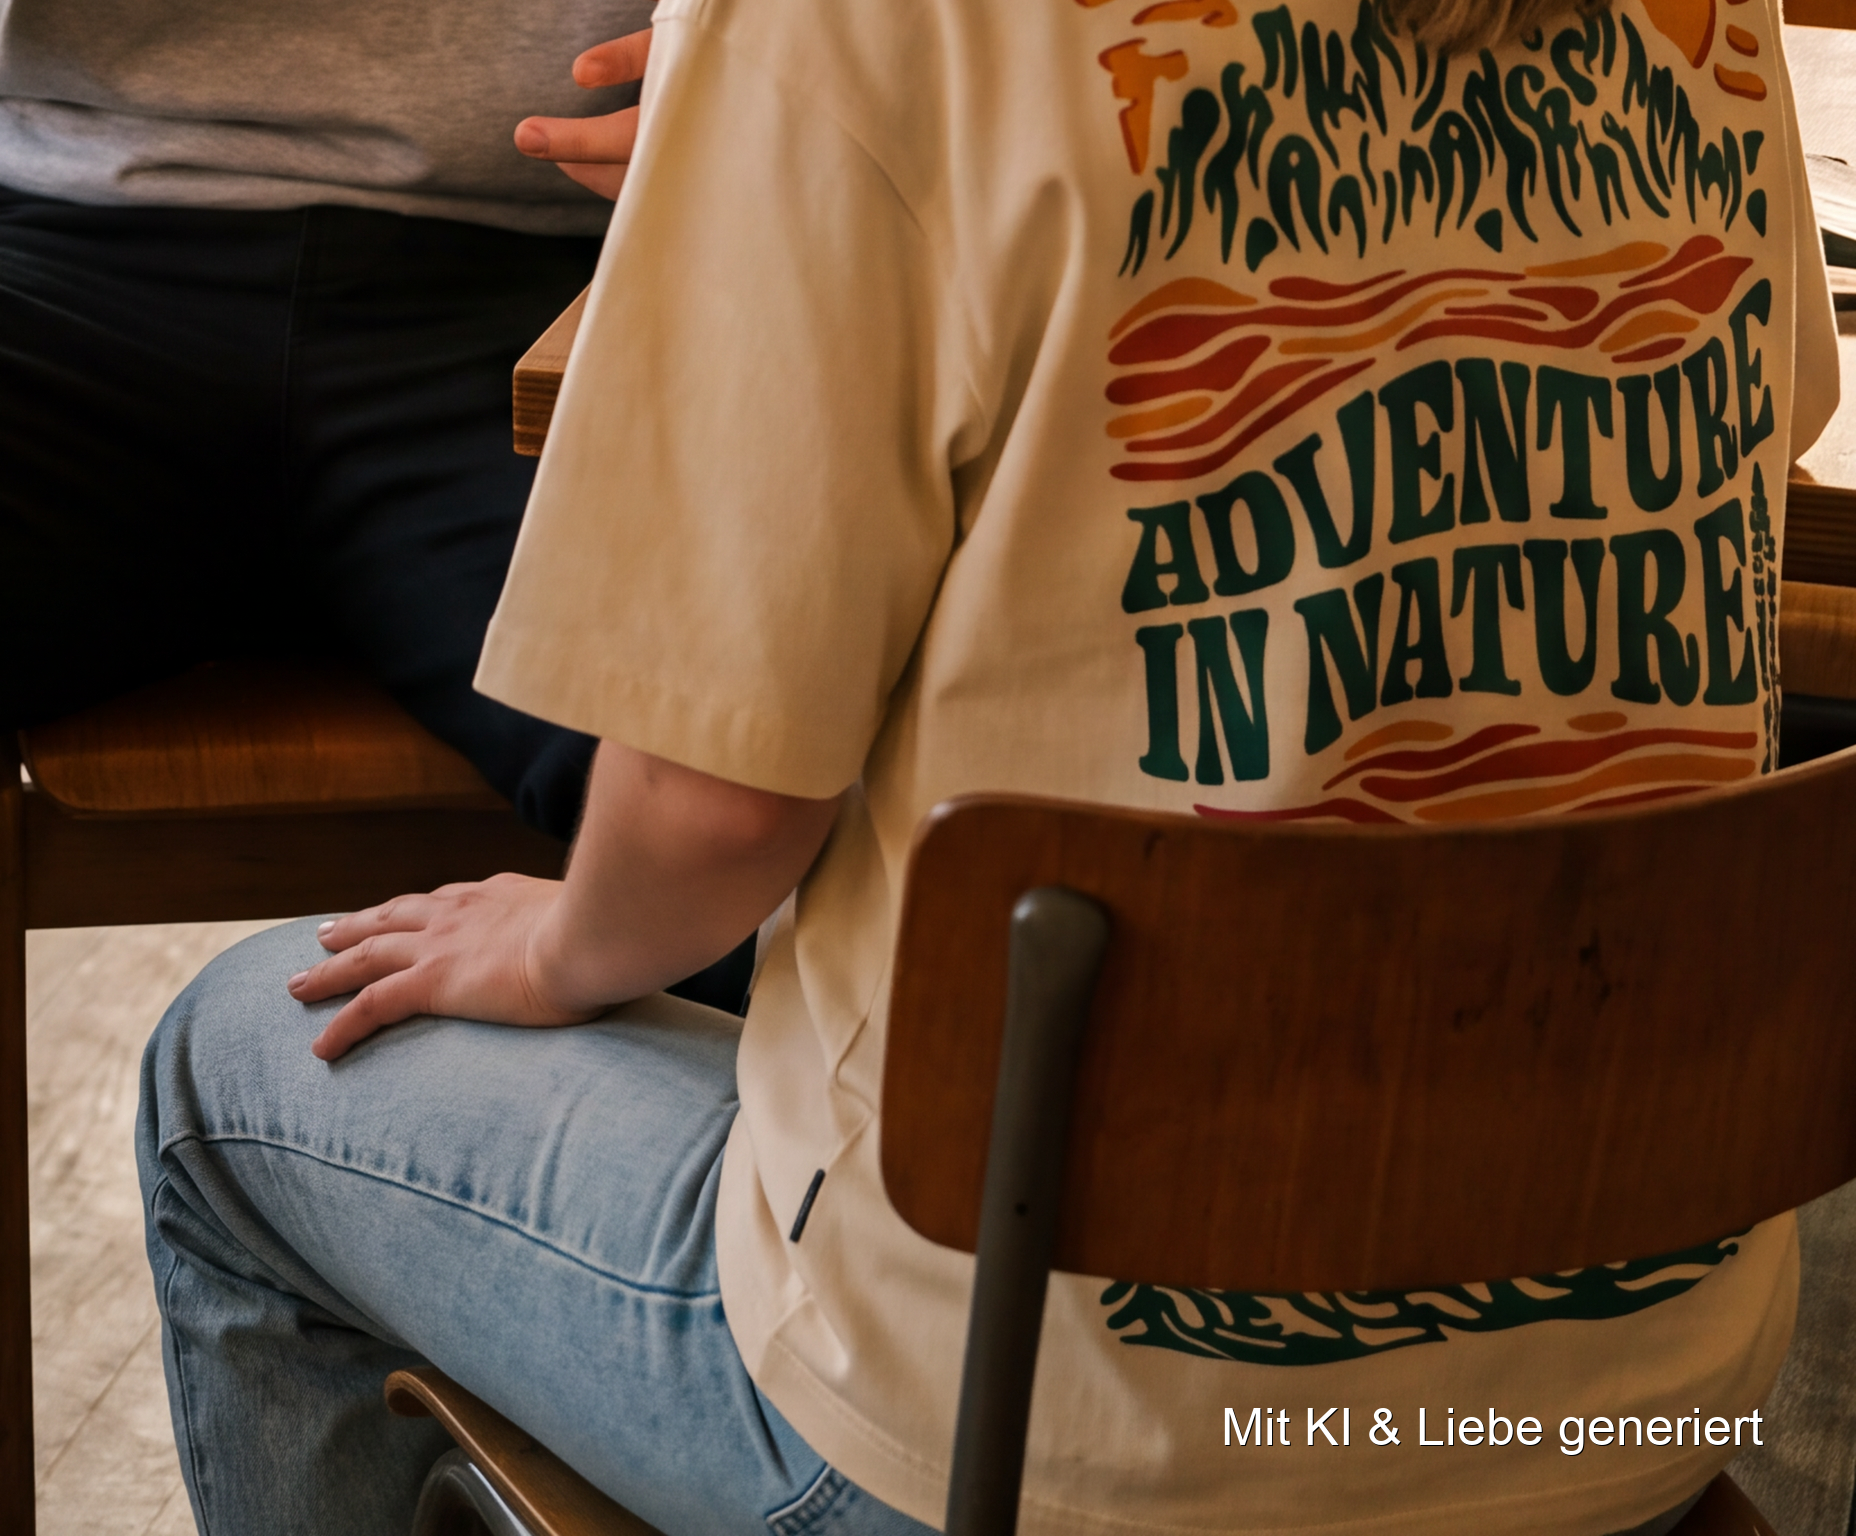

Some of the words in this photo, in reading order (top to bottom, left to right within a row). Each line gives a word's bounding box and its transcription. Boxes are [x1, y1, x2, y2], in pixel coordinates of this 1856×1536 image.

[1121, 278, 1775, 614] ADVENTURE
[1135, 608, 1270, 786] IN
[1294, 497, 1760, 755] NATURE
